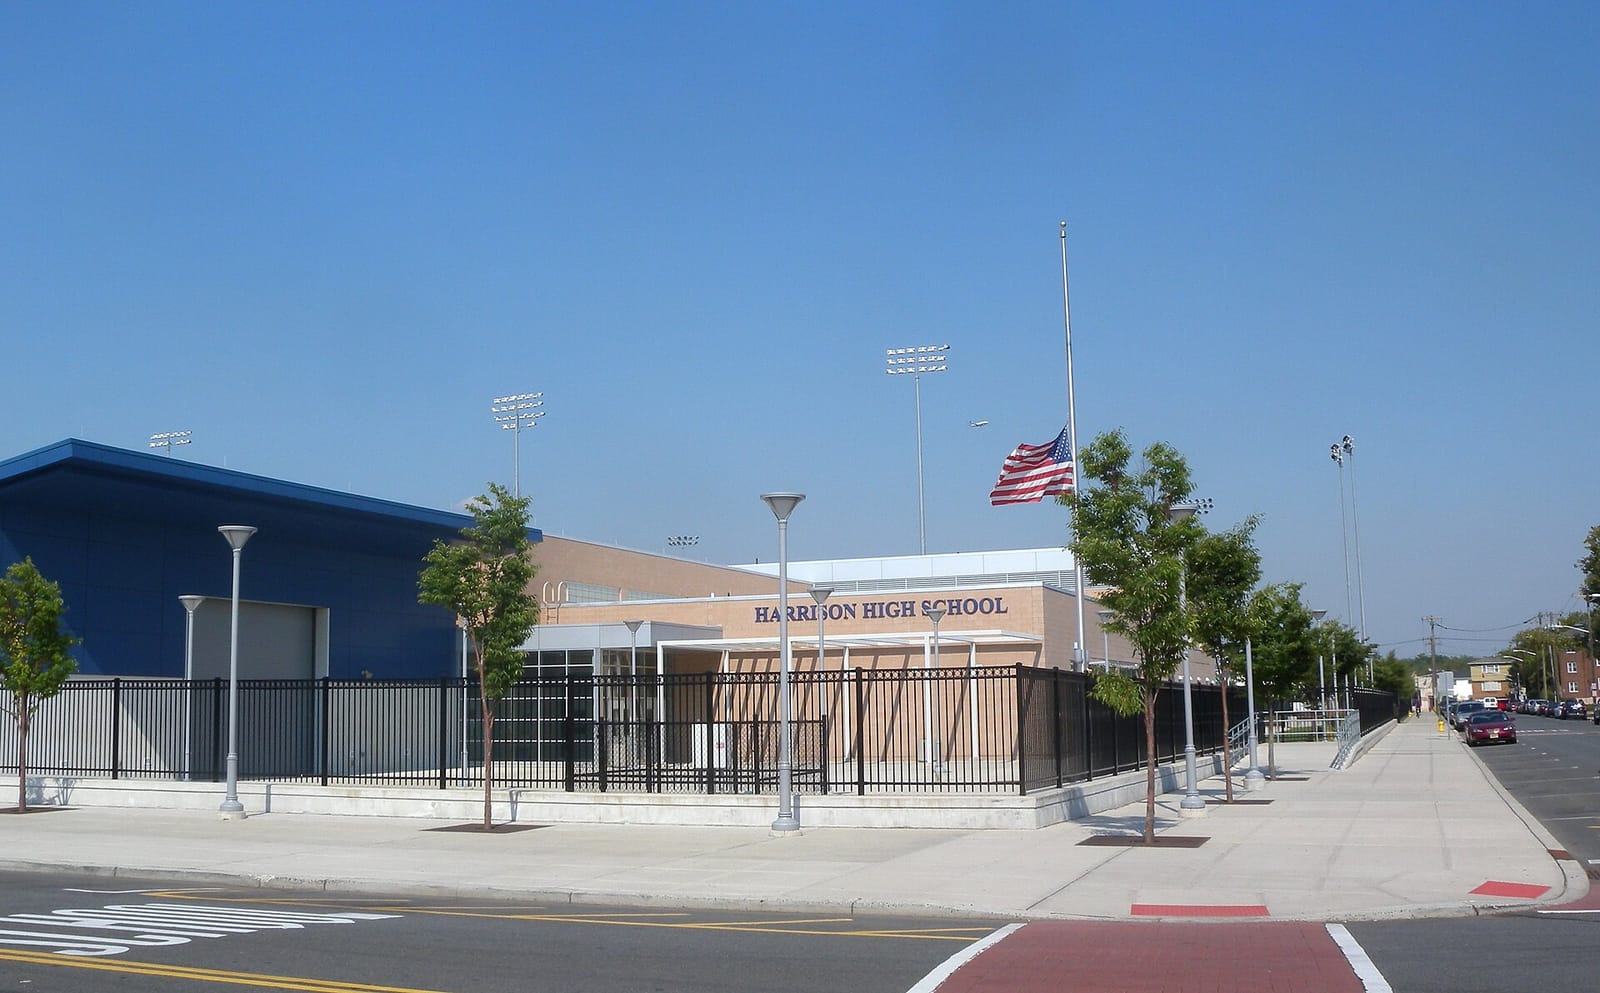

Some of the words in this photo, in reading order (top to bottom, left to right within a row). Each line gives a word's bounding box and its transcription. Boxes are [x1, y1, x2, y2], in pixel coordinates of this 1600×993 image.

[755, 603, 856, 623] HARRISON
[862, 600, 916, 618] HIGH
[921, 597, 1009, 616] SCHOOL
